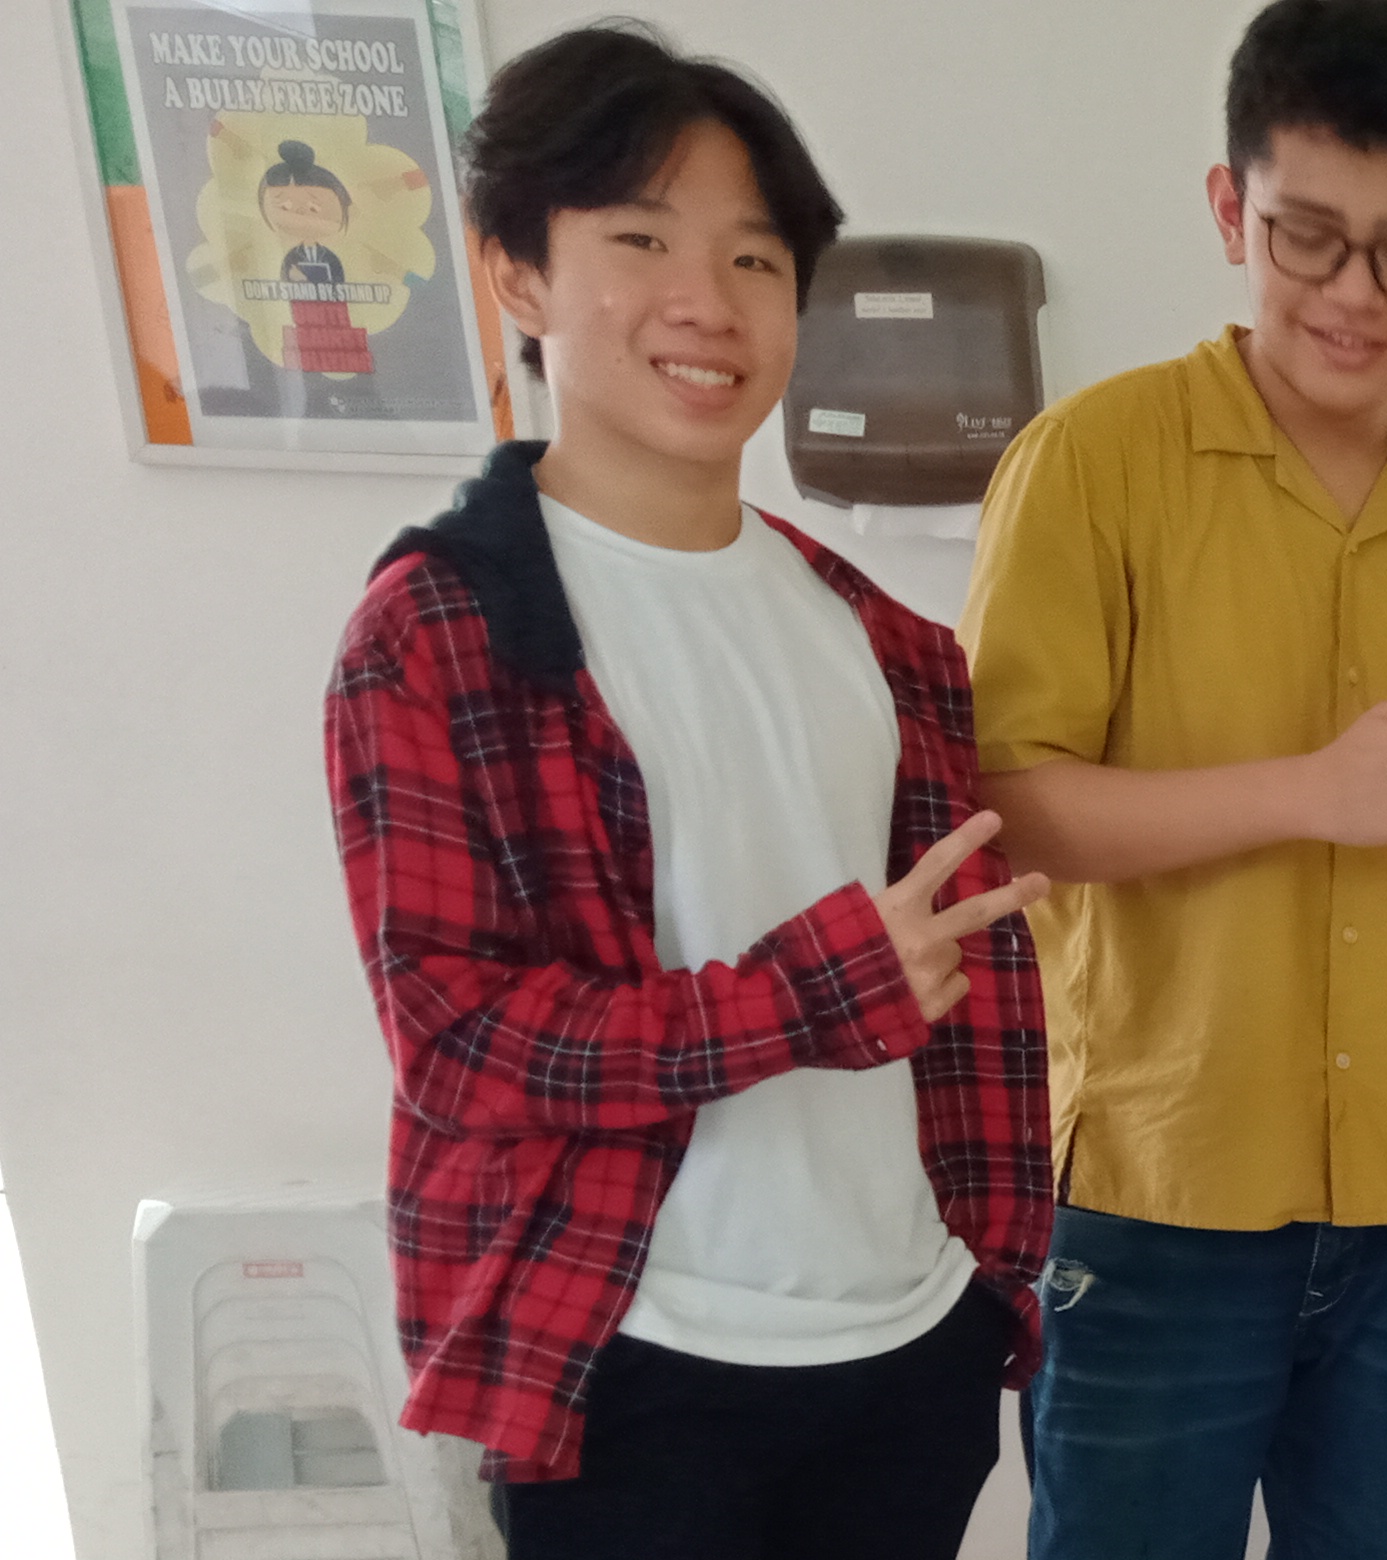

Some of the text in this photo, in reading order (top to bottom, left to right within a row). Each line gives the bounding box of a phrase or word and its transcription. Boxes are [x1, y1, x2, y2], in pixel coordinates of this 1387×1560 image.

[151, 32, 404, 74] MAKE YOUR SCHOOL
[164, 77, 408, 117] A BULLY FREE ZONE
[280, 282, 317, 300] STAND
[337, 283, 373, 302] STAND
[374, 284, 390, 303] UP
